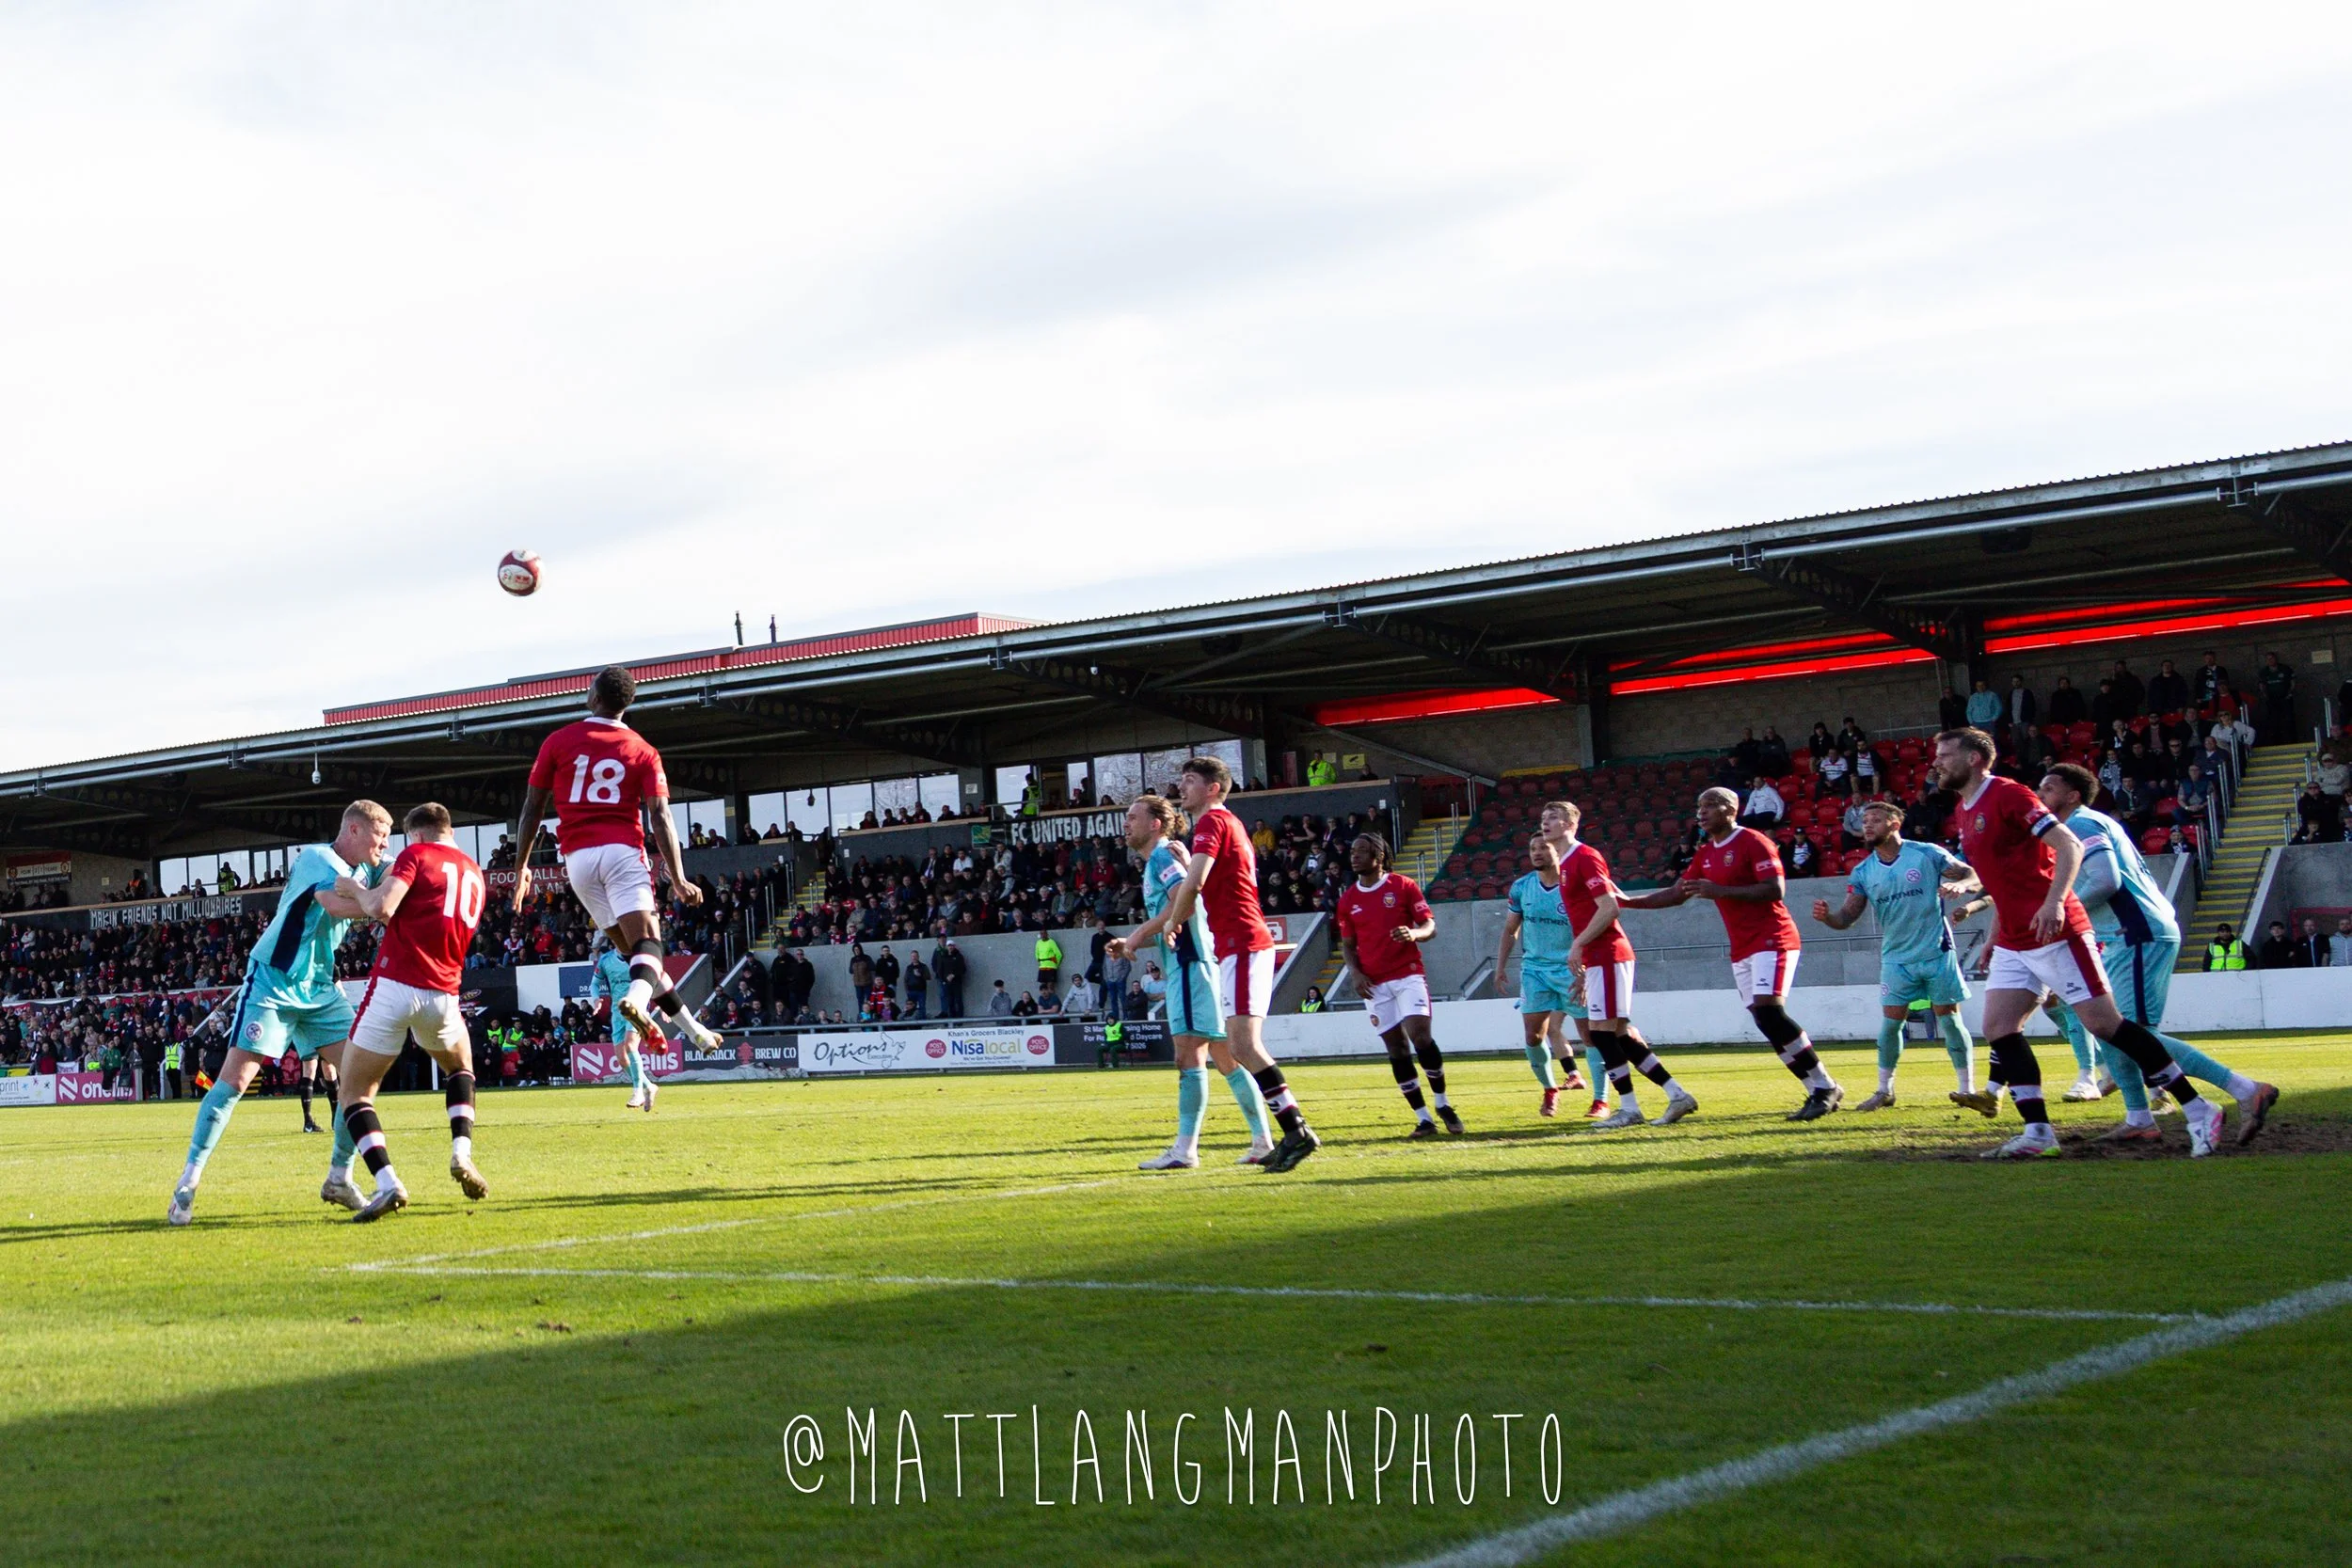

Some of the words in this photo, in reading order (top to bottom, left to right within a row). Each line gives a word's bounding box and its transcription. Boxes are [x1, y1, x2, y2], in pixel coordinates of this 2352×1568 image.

[568, 753, 626, 804] 18
[1010, 822, 1028, 846] FC
[1032, 817, 1082, 844] UNITED
[1086, 812, 1130, 840] AGAIN
[489, 867, 558, 885] FOOALL
[441, 861, 485, 928] 10
[121, 904, 157, 927] FRIENDS
[161, 902, 178, 922] NOT
[182, 895, 242, 920] MILLIONAIRES
[952, 1038, 1021, 1055] Nisalocal
[1136, 1033, 1163, 1042] Daycare
[755, 1047, 782, 1060] BREW
[784, 1047, 797, 1059] CO
[814, 1041, 887, 1067] Options
